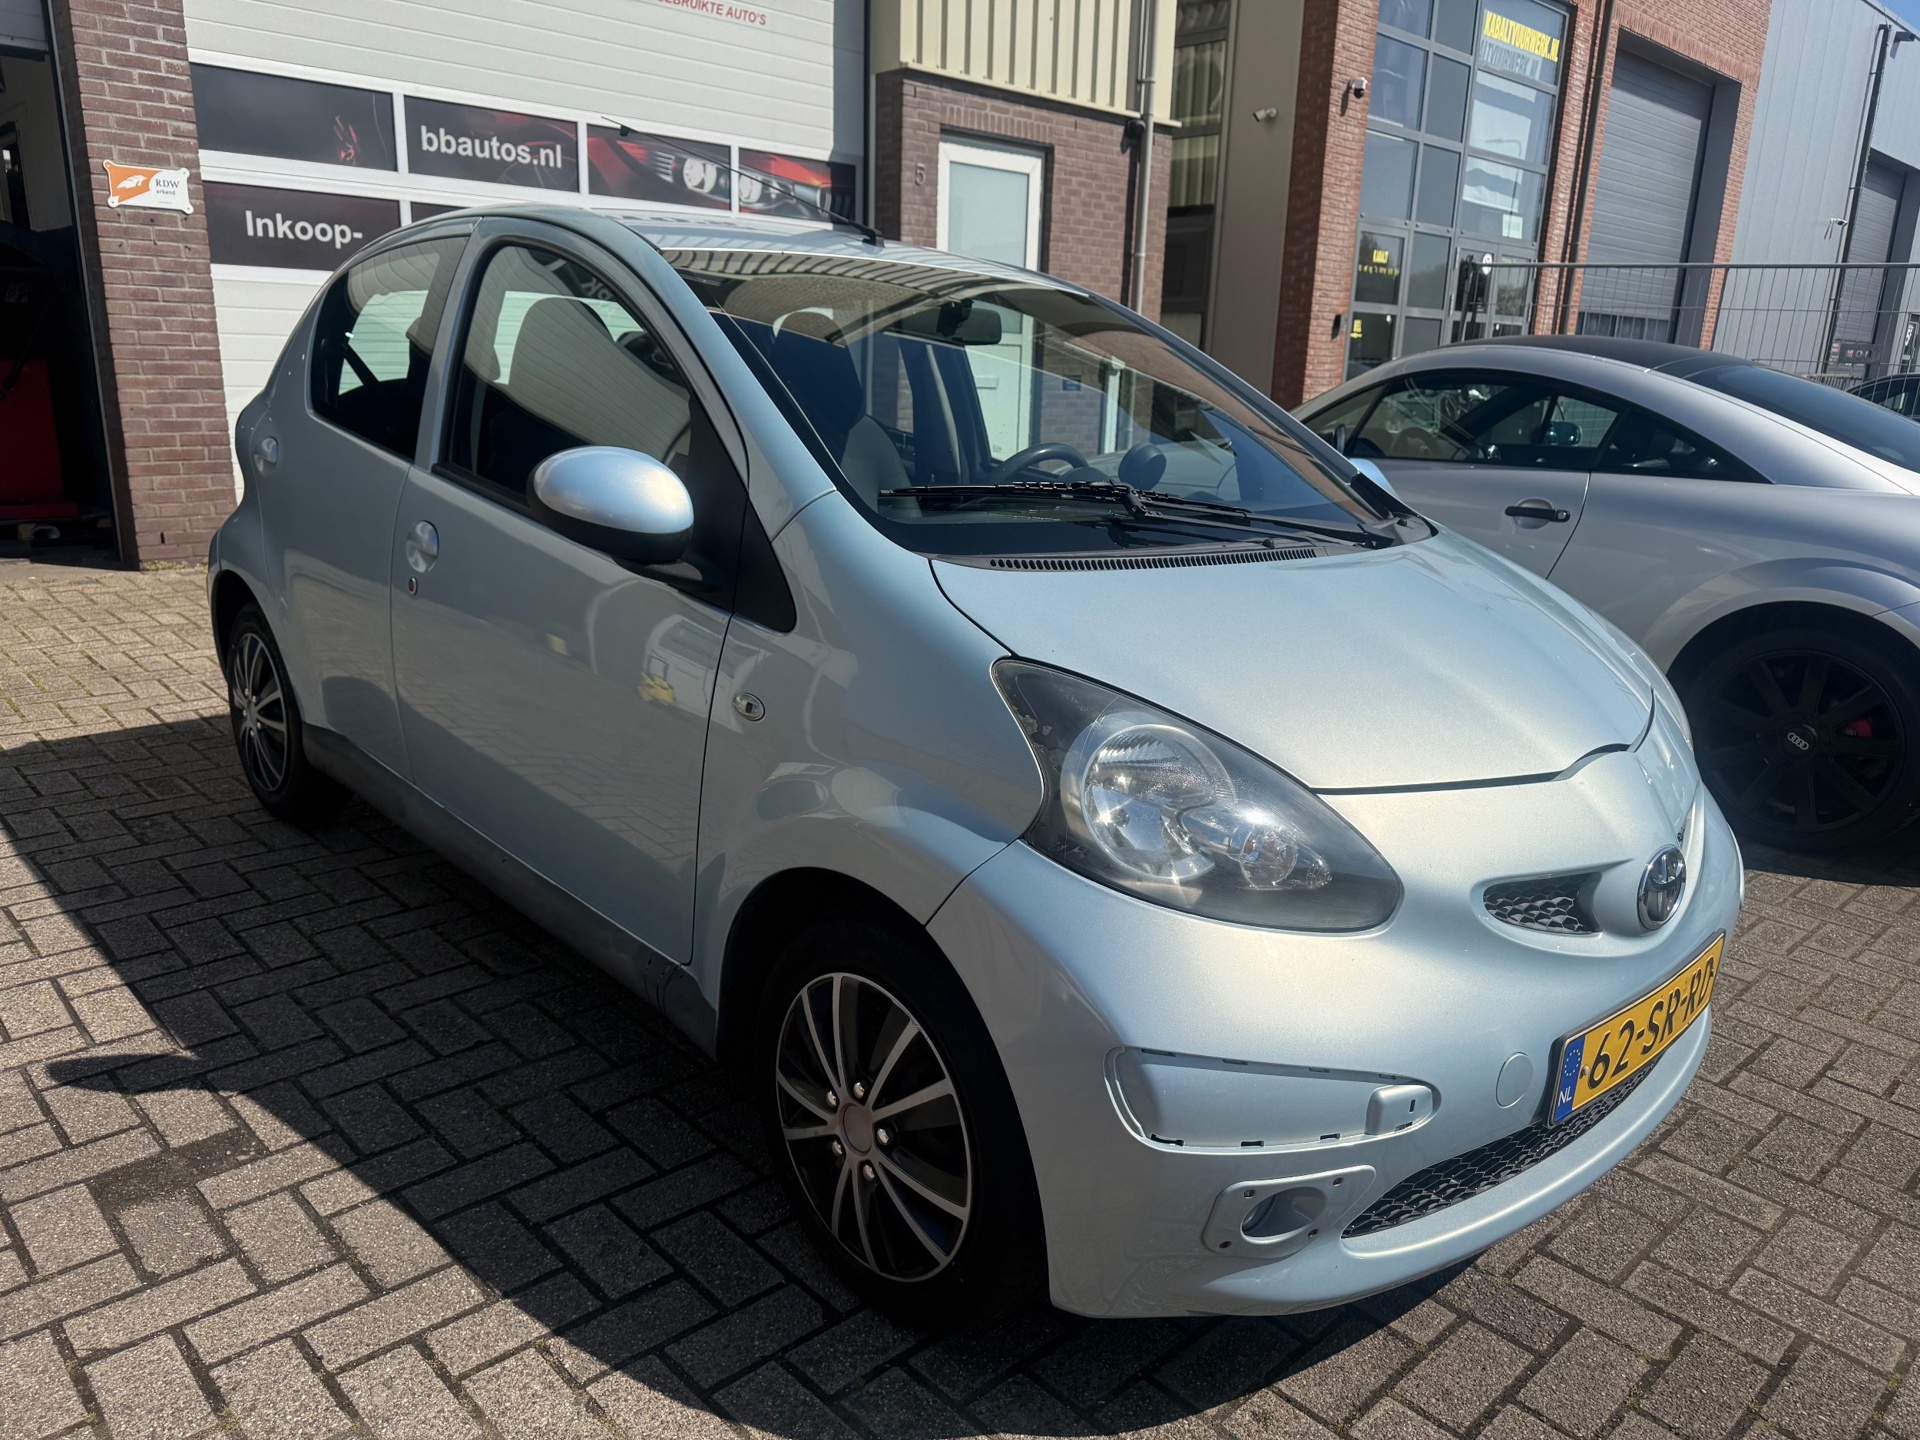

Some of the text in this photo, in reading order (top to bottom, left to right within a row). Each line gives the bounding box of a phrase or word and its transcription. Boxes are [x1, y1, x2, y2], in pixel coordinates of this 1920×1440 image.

[657, 0, 767, 26] RUIKTE AUTO'S
[420, 125, 562, 169] bbautos.nl
[155, 178, 180, 188] RDW
[914, 163, 926, 186] 5
[245, 210, 363, 249] Inkoop-
[1588, 956, 1715, 1090] 62-SR-RD
[1557, 1086, 1573, 1107] NL
